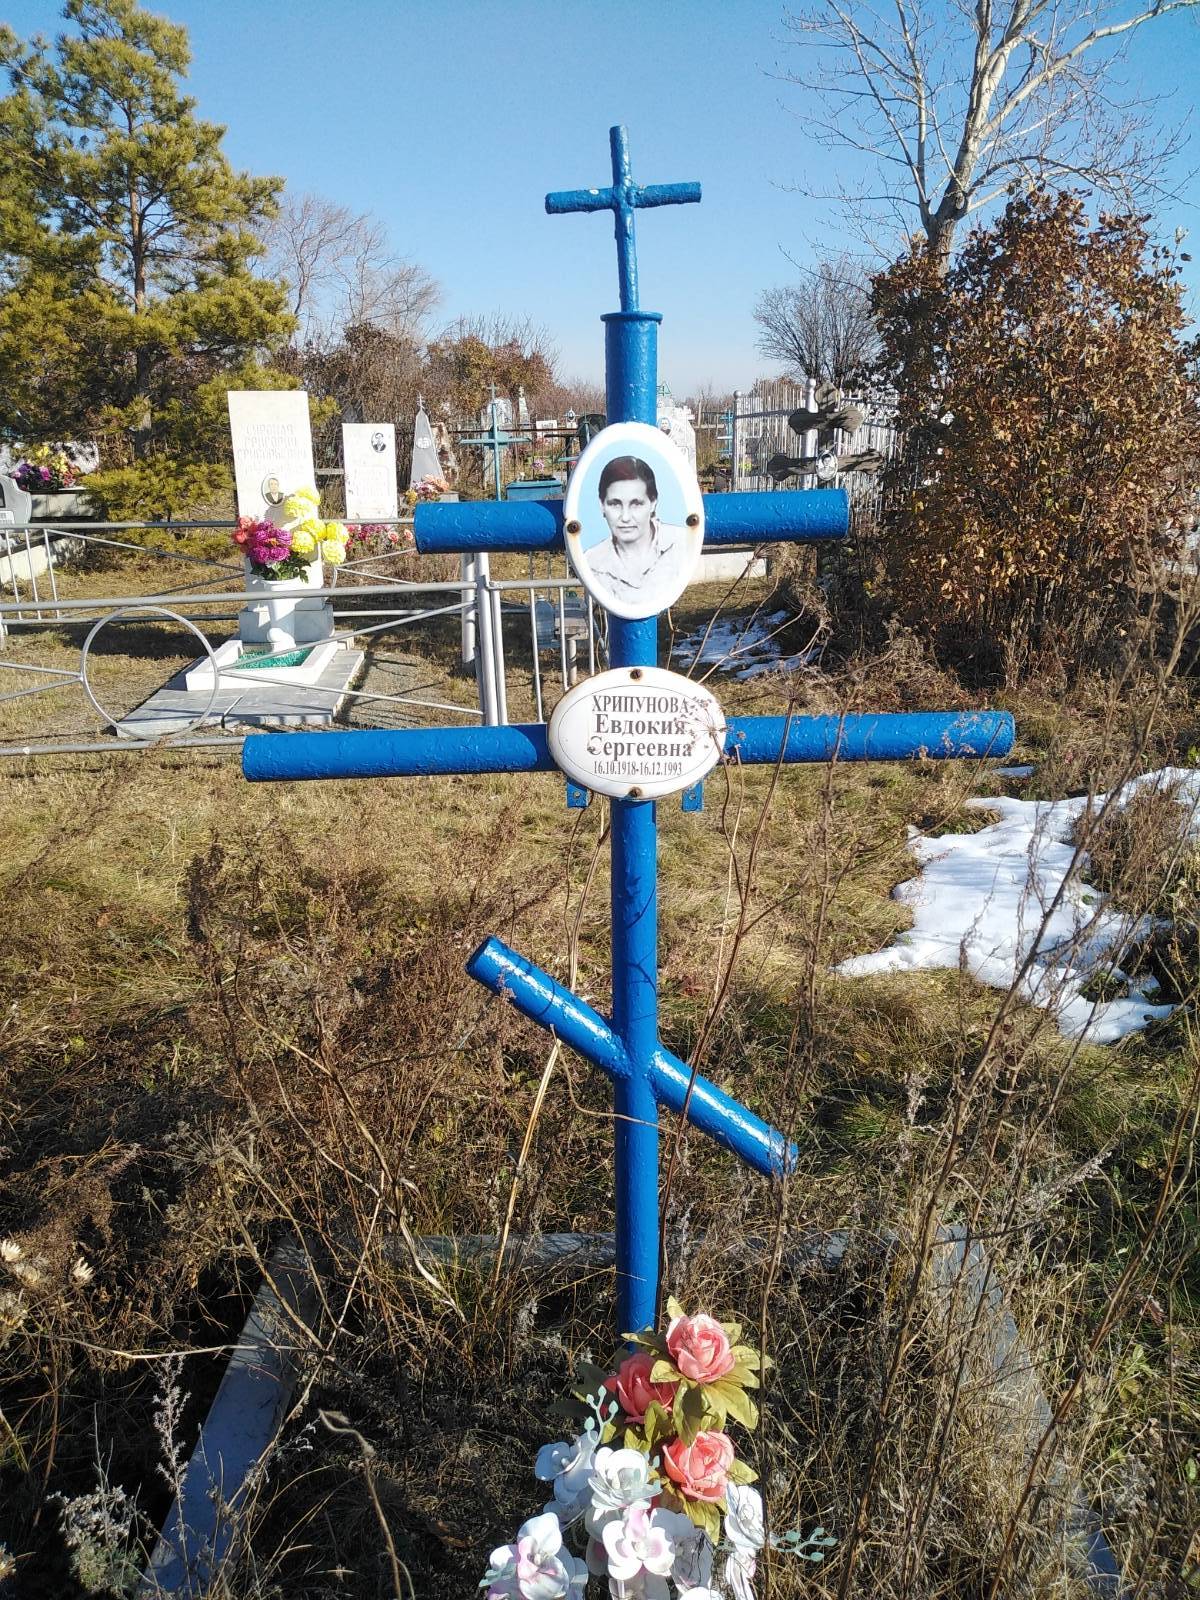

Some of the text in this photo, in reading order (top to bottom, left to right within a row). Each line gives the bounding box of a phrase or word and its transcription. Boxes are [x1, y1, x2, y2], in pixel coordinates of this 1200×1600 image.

[592, 695, 690, 713] ХРИПУНОВА
[595, 713, 686, 736] Евдокия
[587, 735, 692, 761] Сергеевна
